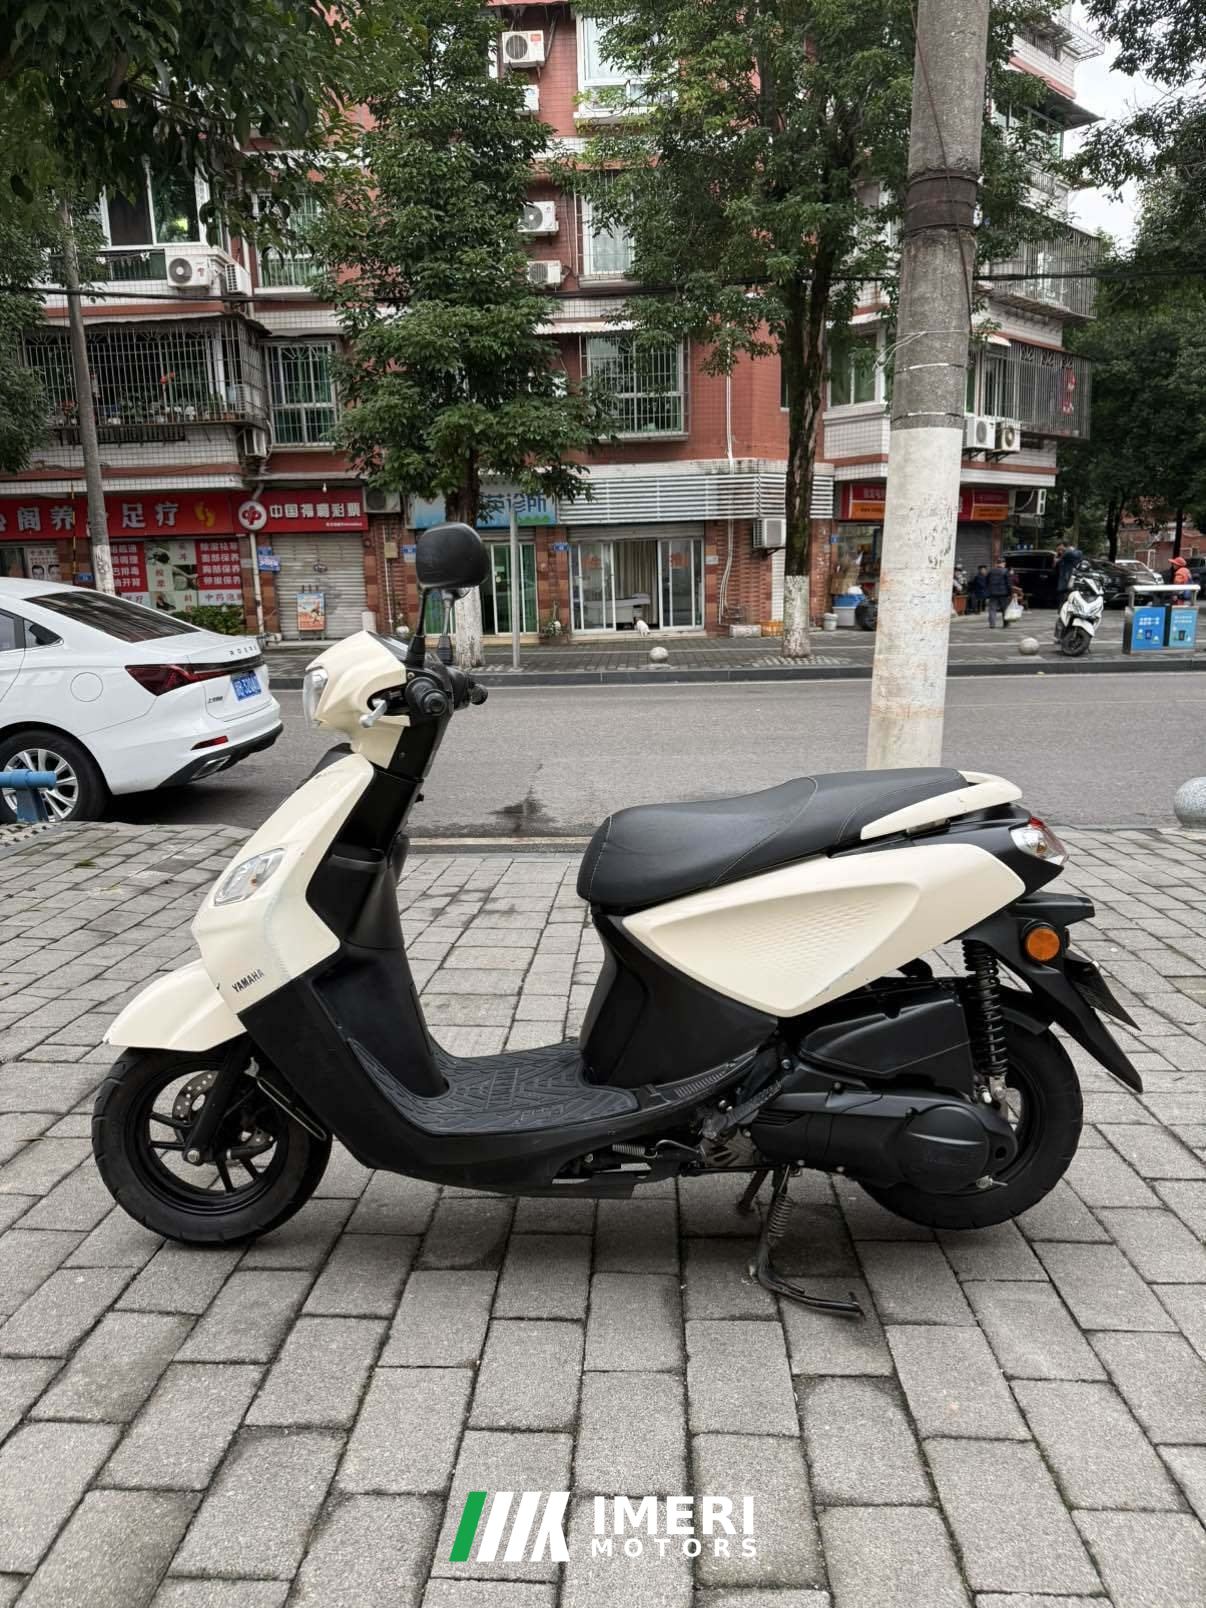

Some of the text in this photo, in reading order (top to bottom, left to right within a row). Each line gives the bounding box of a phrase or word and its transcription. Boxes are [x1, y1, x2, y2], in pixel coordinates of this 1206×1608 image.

[0, 501, 179, 532] 阁养足疗
[112, 566, 140, 577] 巴排毒
[232, 969, 264, 992] YAMAHA
